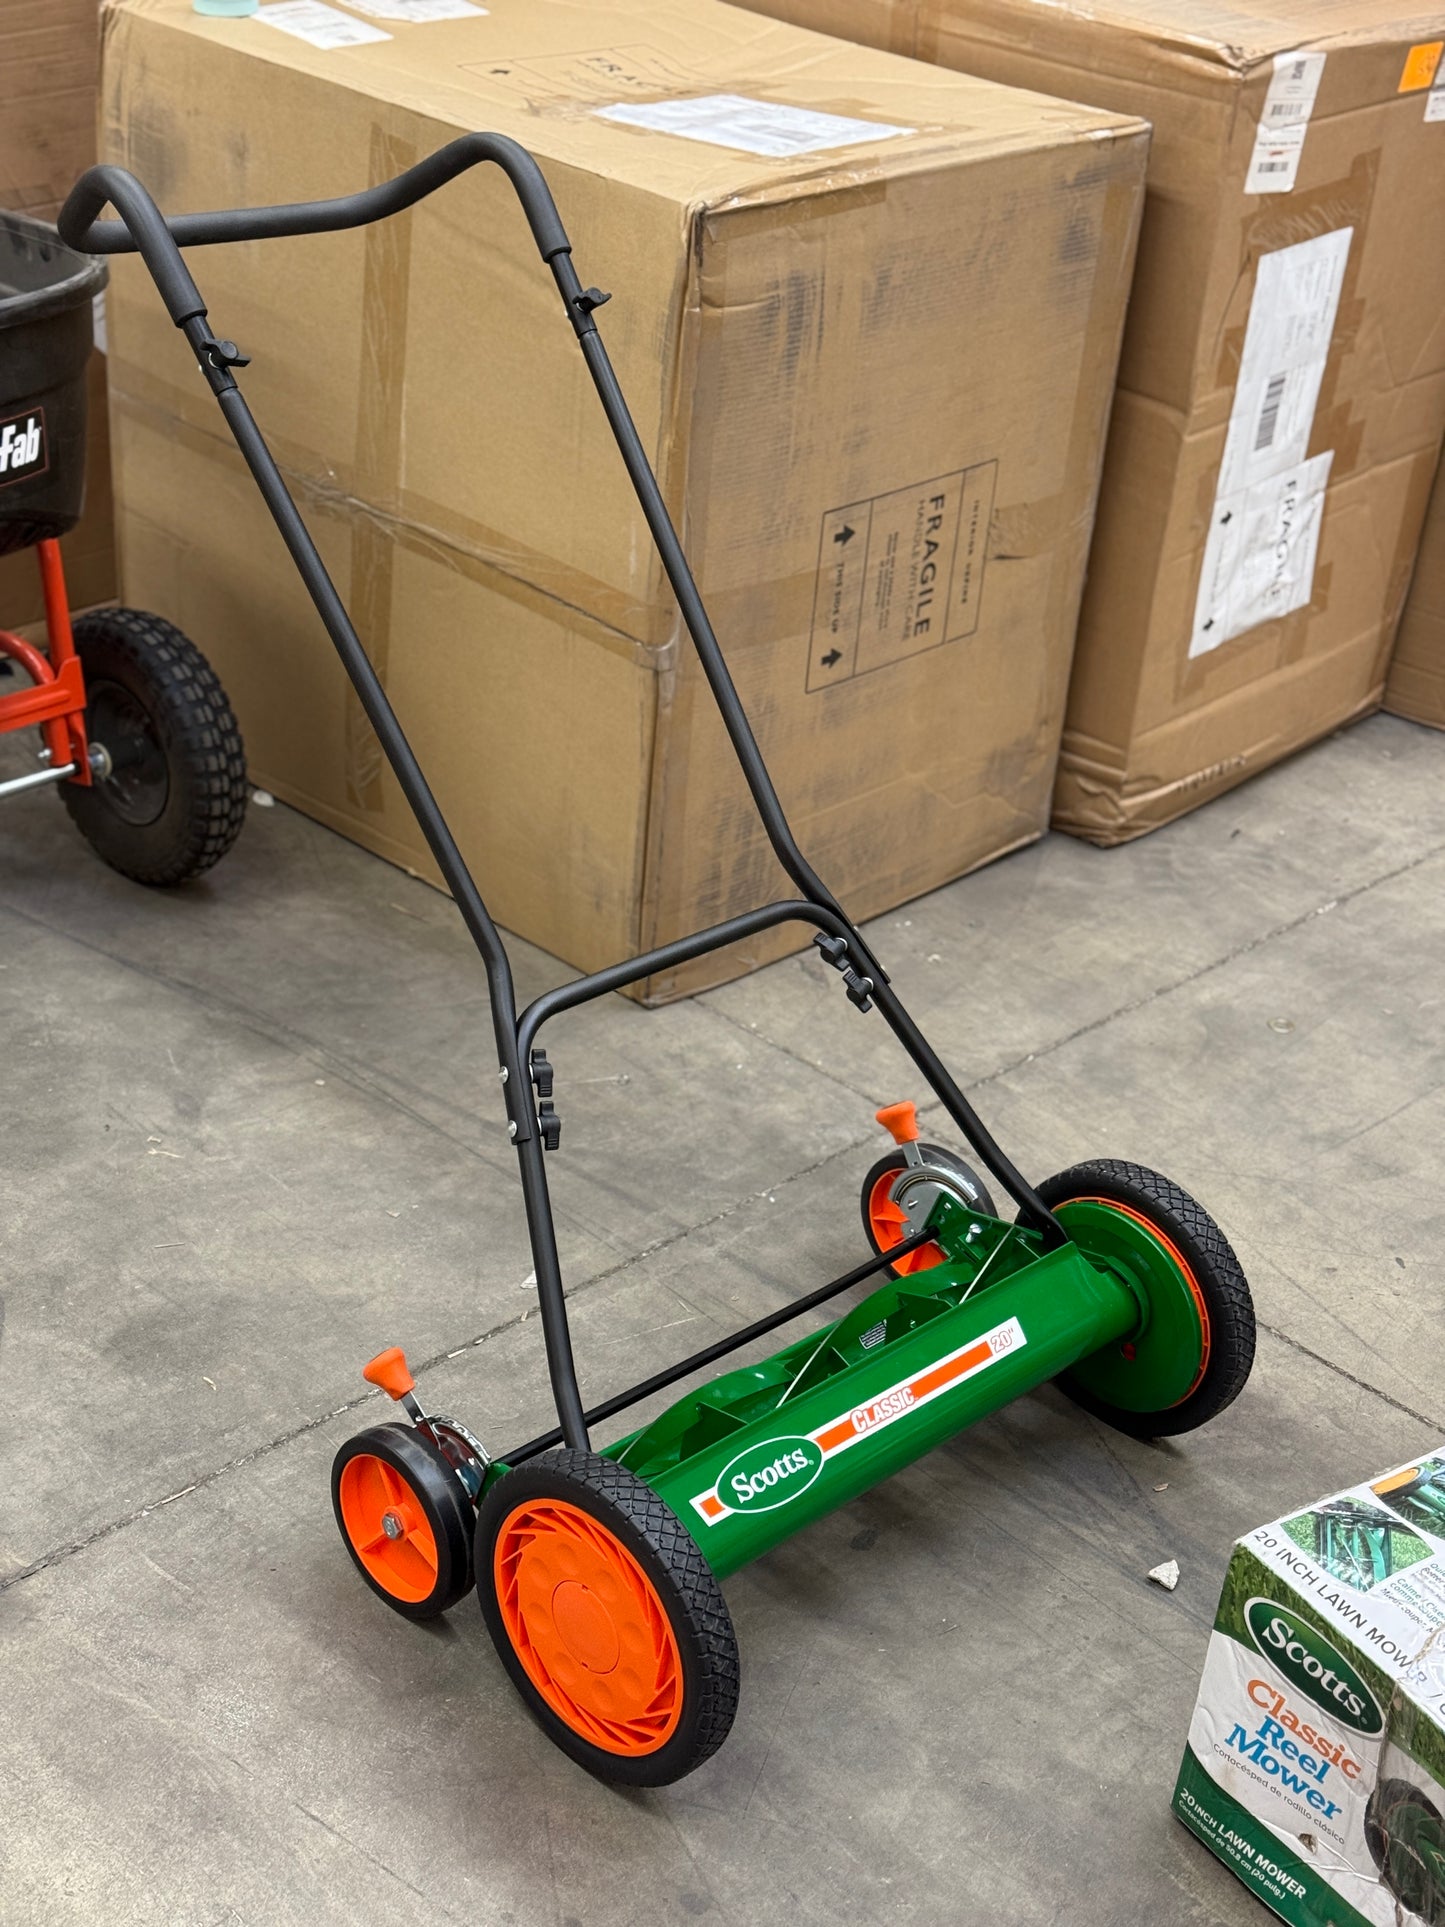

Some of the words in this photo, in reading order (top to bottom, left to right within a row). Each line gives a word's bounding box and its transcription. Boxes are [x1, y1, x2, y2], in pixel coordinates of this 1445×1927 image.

[0, 417, 41, 473] Fab
[911, 498, 925, 560] HANDLE
[835, 561, 844, 587] THIS
[906, 562, 918, 602] WITH
[913, 493, 945, 637] FRAGILE
[830, 617, 839, 635] UP
[902, 603, 914, 641] CARE
[731, 1448, 808, 1503] Scotts
[1254, 1531, 1277, 1548] 20
[1276, 1548, 1319, 1585] INCH
[1317, 1584, 1367, 1629] LAWN
[1262, 1618, 1366, 1716] Scotts
[1247, 1679, 1361, 1779] Classic
[1255, 1716, 1331, 1784] Reel
[1213, 1743, 1268, 1788] Cortacésped
[1269, 1786, 1282, 1797] de
[1283, 1796, 1312, 1819] rodillo
[1313, 1818, 1345, 1845] clásico
[1224, 1723, 1342, 1820] Mower
[1180, 1787, 1195, 1806] 20
[1194, 1804, 1218, 1828] INCH
[1218, 1824, 1255, 1859] LAWN
[1255, 1854, 1307, 1899] MOWER
[1216, 1836, 1225, 1848] de
[1225, 1844, 1241, 1861] 50.8
[1240, 1859, 1252, 1872] cm
[1250, 1868, 1265, 1881] (20
[1263, 1880, 1286, 1900] pulg.)
